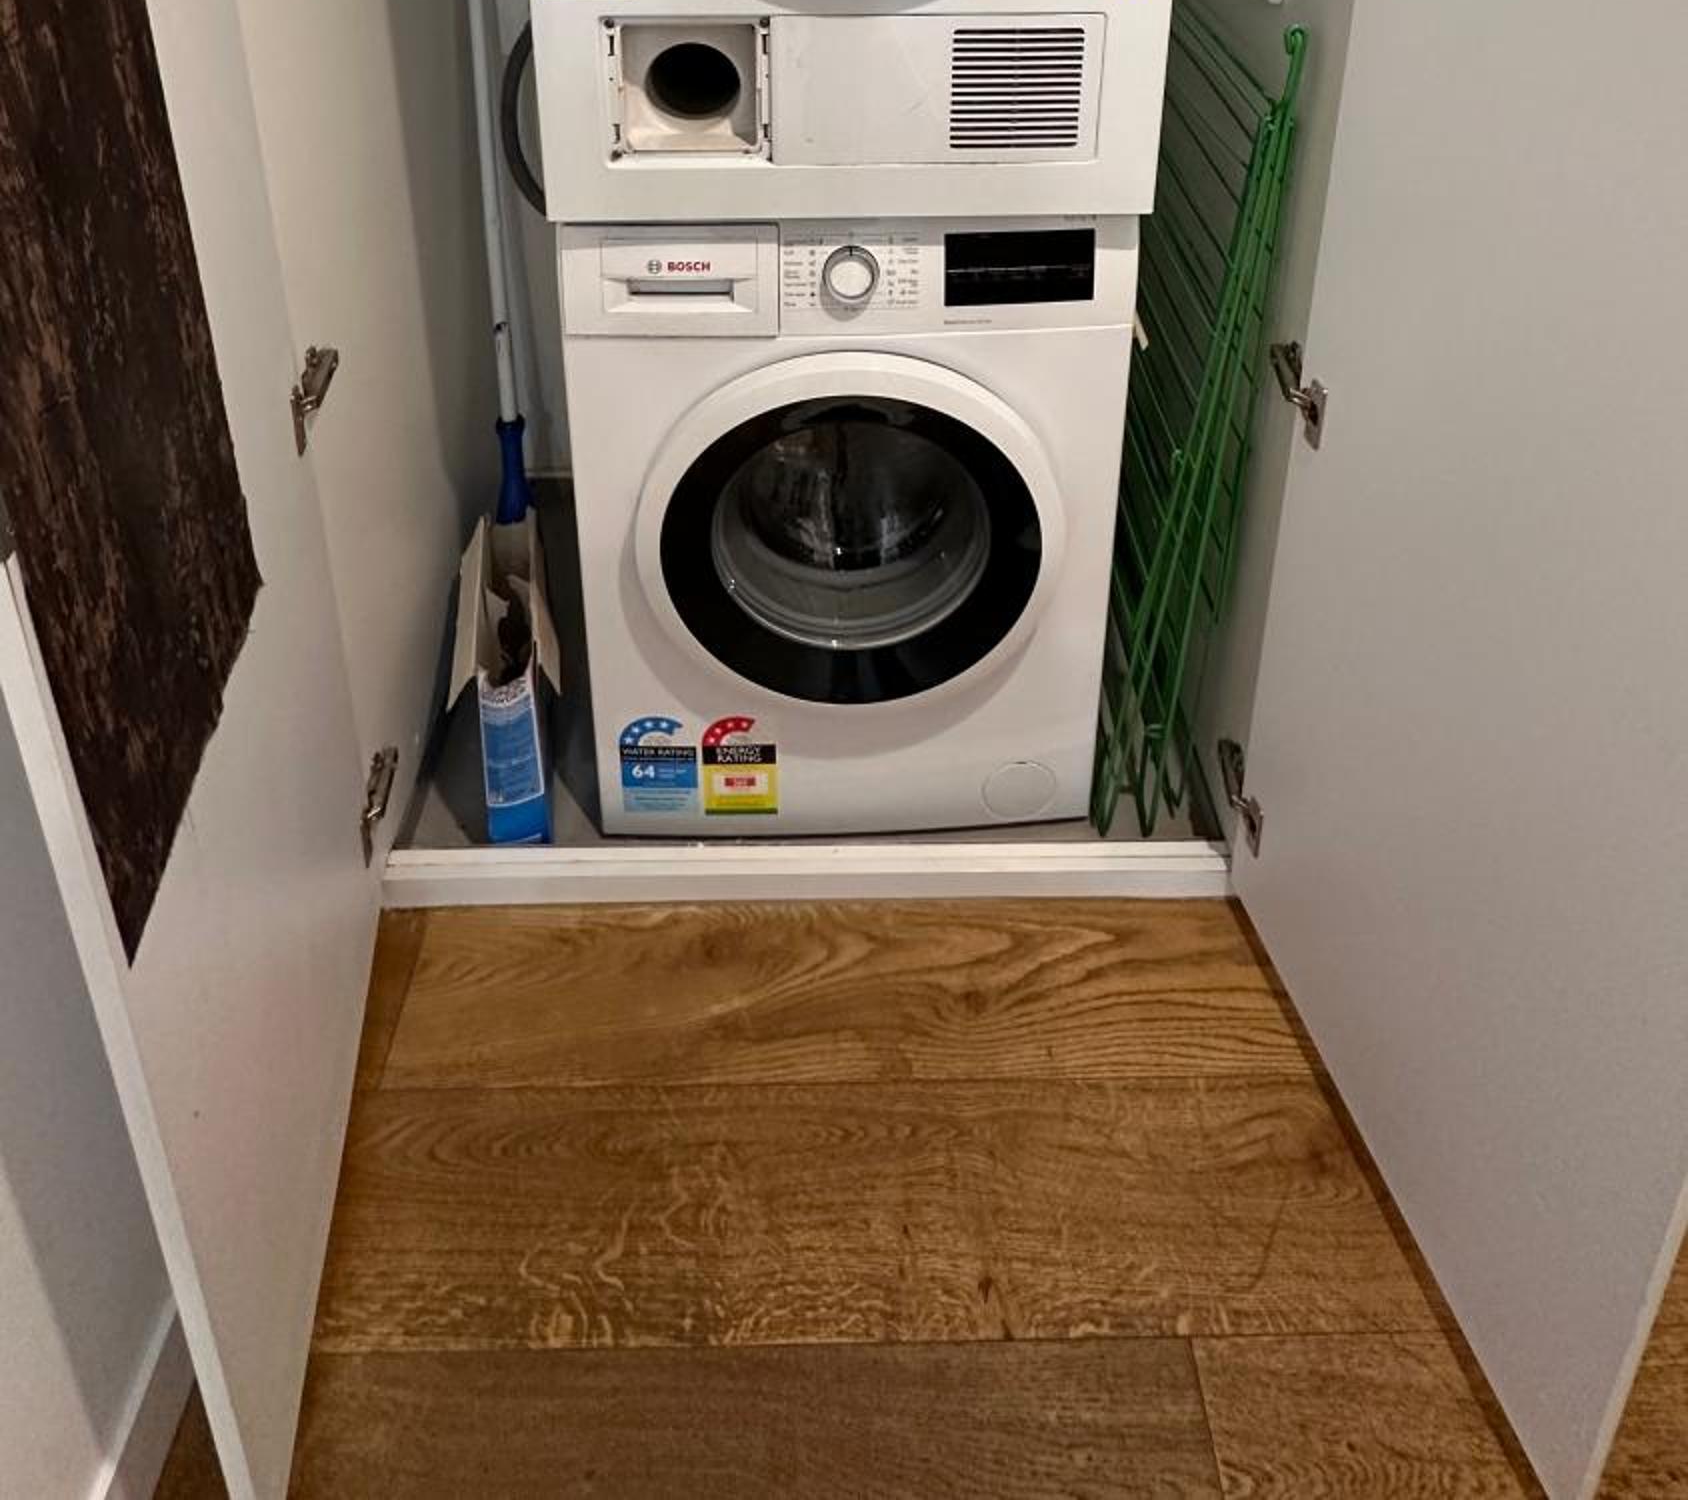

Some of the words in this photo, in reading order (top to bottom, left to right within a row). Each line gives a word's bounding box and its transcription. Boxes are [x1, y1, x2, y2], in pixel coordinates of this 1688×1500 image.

[667, 261, 711, 272] BOSCH
[623, 747, 655, 757] WATER
[715, 746, 761, 755] ENERGY
[717, 755, 763, 763] RATING
[631, 765, 656, 779] 64
